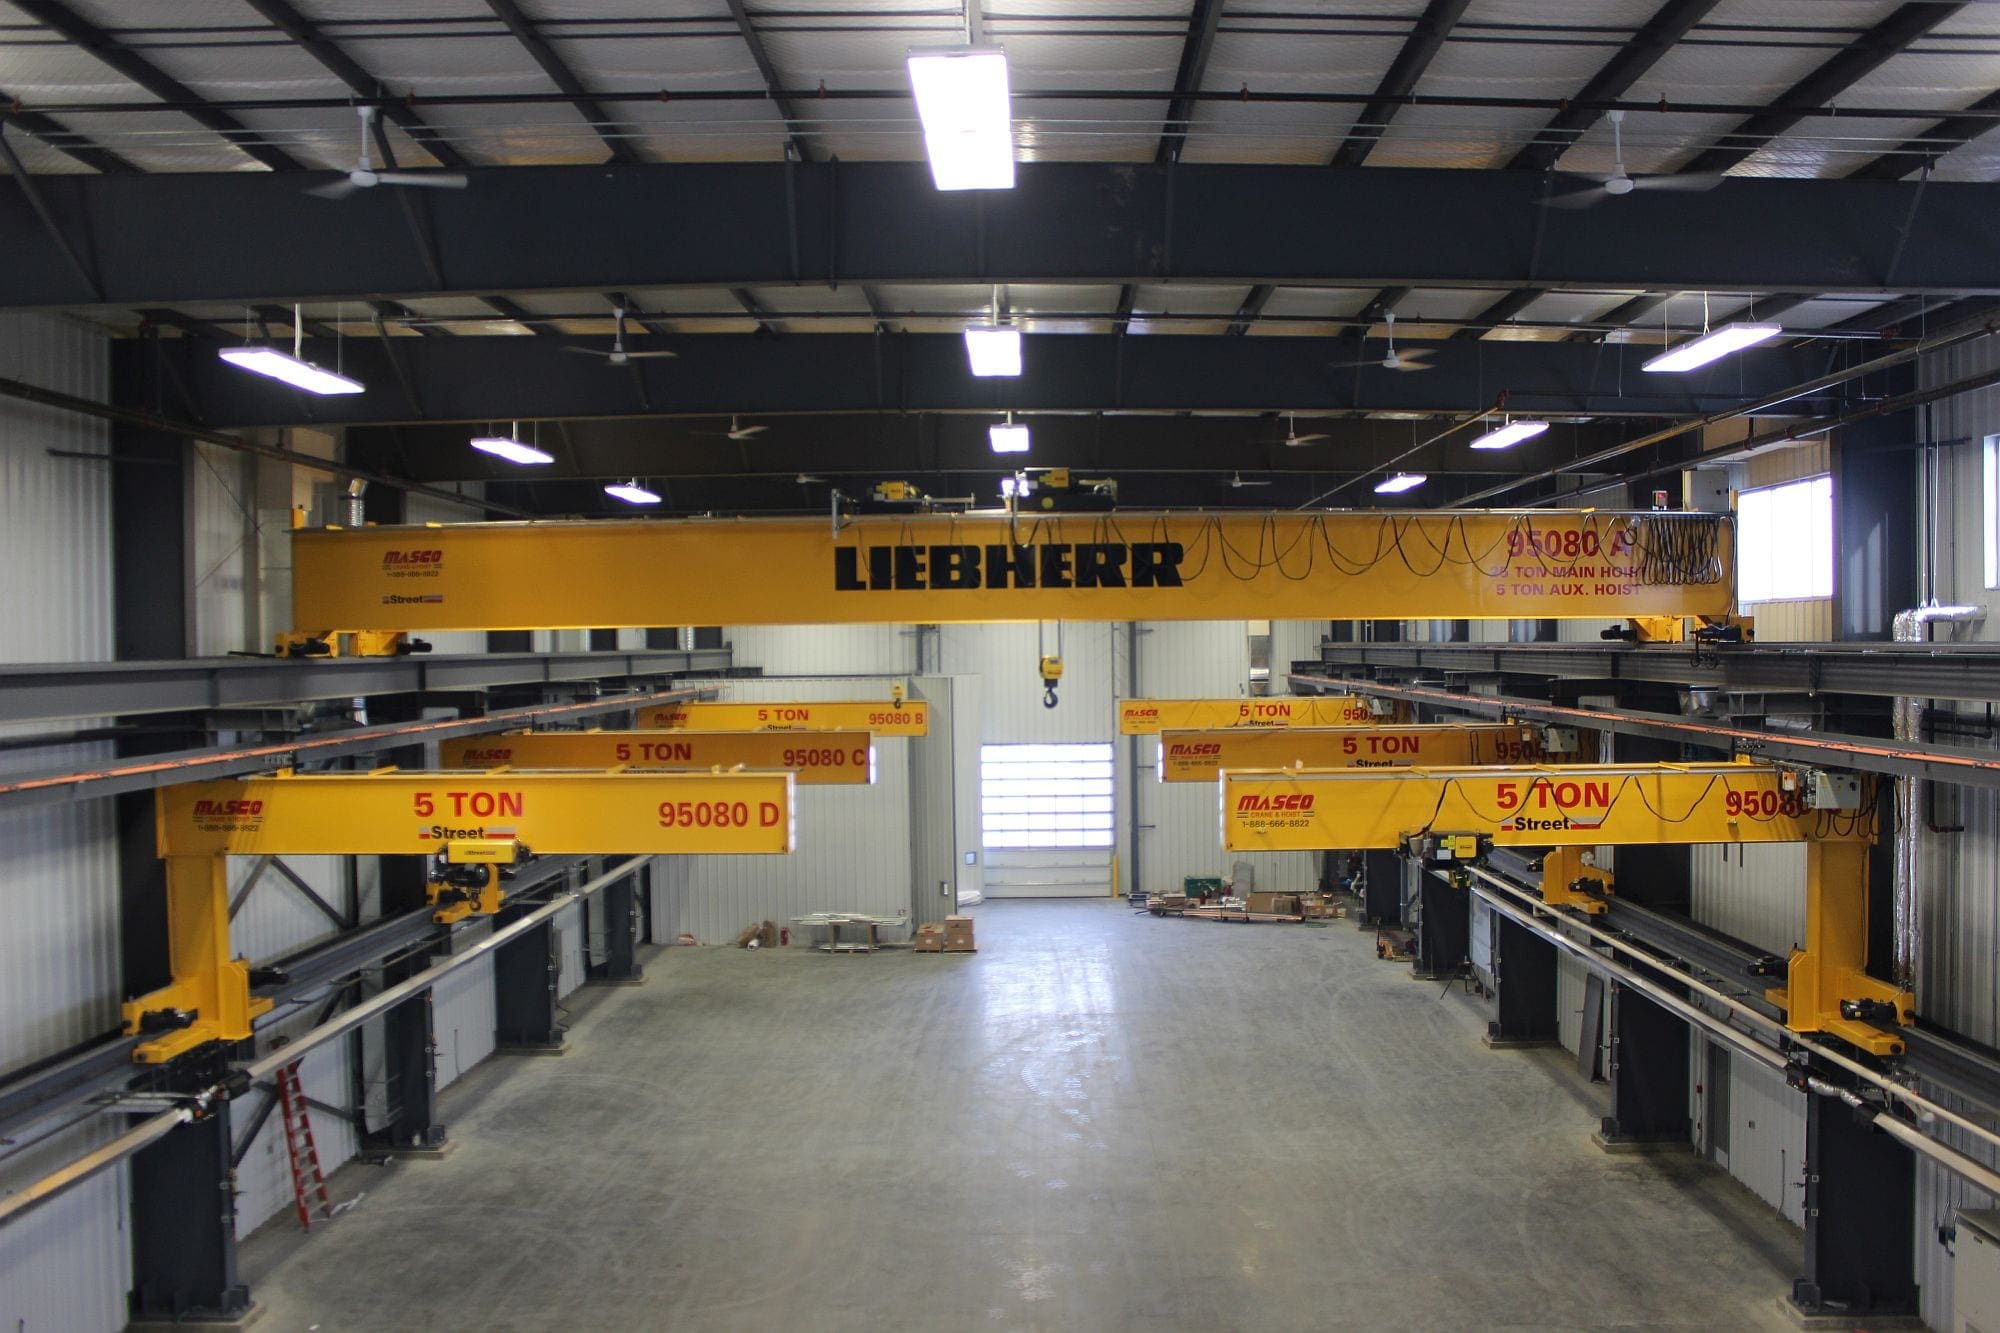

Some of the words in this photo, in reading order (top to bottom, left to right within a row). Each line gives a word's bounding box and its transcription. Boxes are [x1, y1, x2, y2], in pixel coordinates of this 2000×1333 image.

[1507, 529, 1599, 557] 95080
[1610, 530, 1633, 557] A
[383, 550, 442, 564] MASCO
[835, 543, 1183, 591] LIEBHERR
[1514, 566, 1547, 578] TON
[1551, 565, 1595, 578] MAIN
[1496, 583, 1506, 596] 5
[1511, 583, 1544, 596] TON
[1550, 583, 1589, 596] AUX.
[1594, 583, 1641, 596] HOIST
[390, 594, 423, 604] Street
[758, 709, 768, 721] 5
[773, 709, 809, 721] TON
[1240, 704, 1250, 717] 5
[1255, 704, 1291, 717] TON
[868, 713, 910, 725] 95080
[915, 713, 923, 725] B
[616, 743, 631, 761] 5
[638, 743, 692, 761] TON
[1170, 744, 1222, 755] MASCO
[1343, 737, 1358, 755] 5
[1366, 736, 1419, 754] TON
[783, 749, 845, 767] 95080
[852, 749, 865, 767] C
[1237, 794, 1315, 811] MASCO
[1497, 783, 1518, 810] 5
[1533, 782, 1609, 809] TON
[192, 800, 263, 816] MASCO
[414, 792, 434, 818] 5
[446, 791, 523, 818] TON
[658, 801, 748, 828] 95080
[759, 802, 780, 828] D
[1242, 819, 1310, 828] 1-888-666-8822
[1515, 816, 1570, 831] Street
[431, 825, 485, 840] Street
